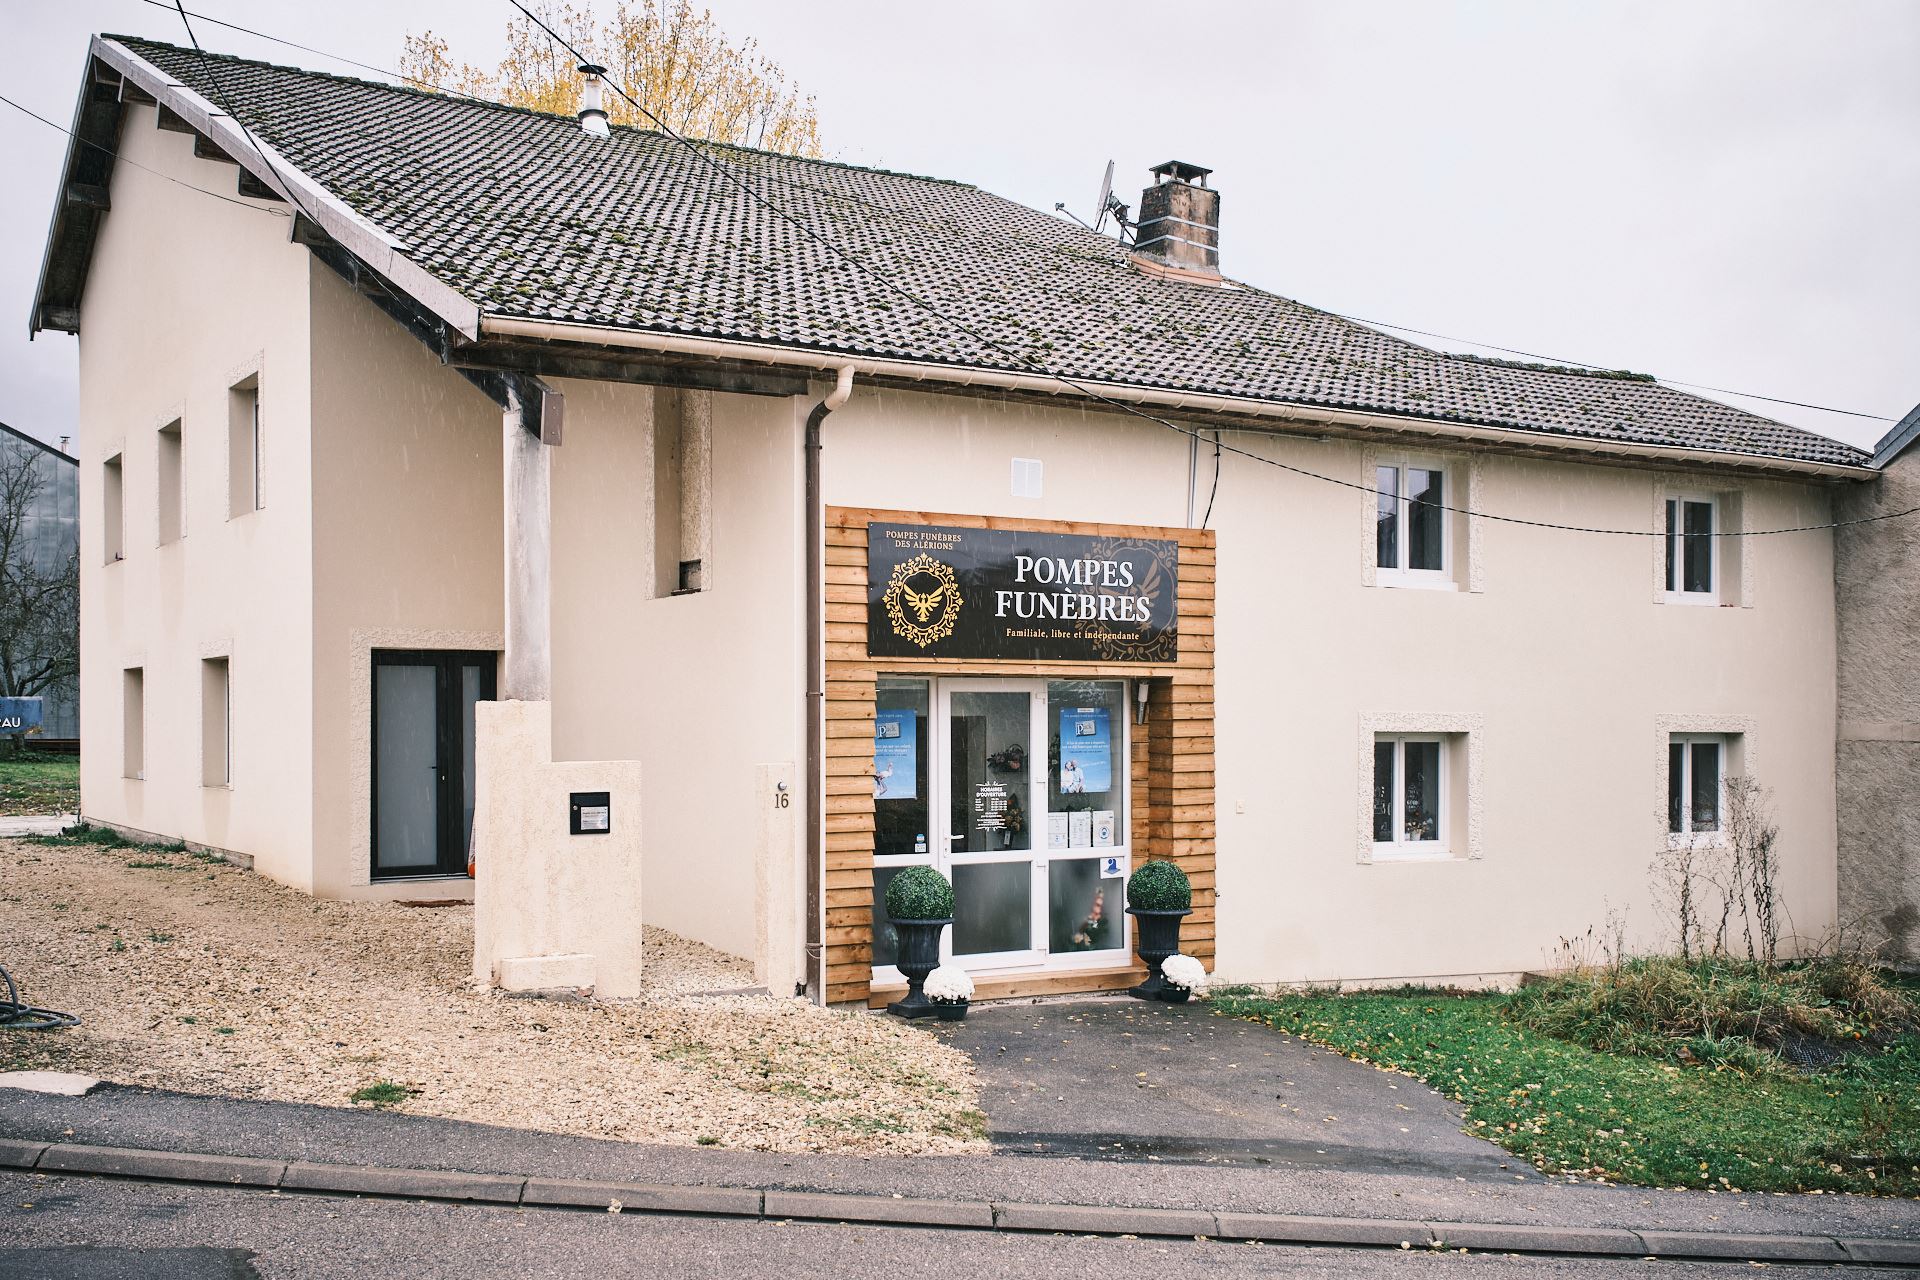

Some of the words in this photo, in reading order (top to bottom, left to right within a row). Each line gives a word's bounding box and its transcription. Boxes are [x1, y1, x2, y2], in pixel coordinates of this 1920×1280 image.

[886, 530, 919, 540] POMPES
[921, 532, 962, 542] FUNÈBRES
[895, 540, 911, 548] DES
[913, 541, 953, 550] ALÉRIONS
[1014, 555, 1134, 588] POMPES
[994, 586, 1151, 622] FUNÈBRES
[1006, 628, 1049, 639] Familiale,
[1051, 630, 1071, 639] libre
[1074, 631, 1082, 639] et
[1084, 630, 1140, 641] indépendante
[0, 717, 21, 728] AU
[774, 793, 789, 809] 16
